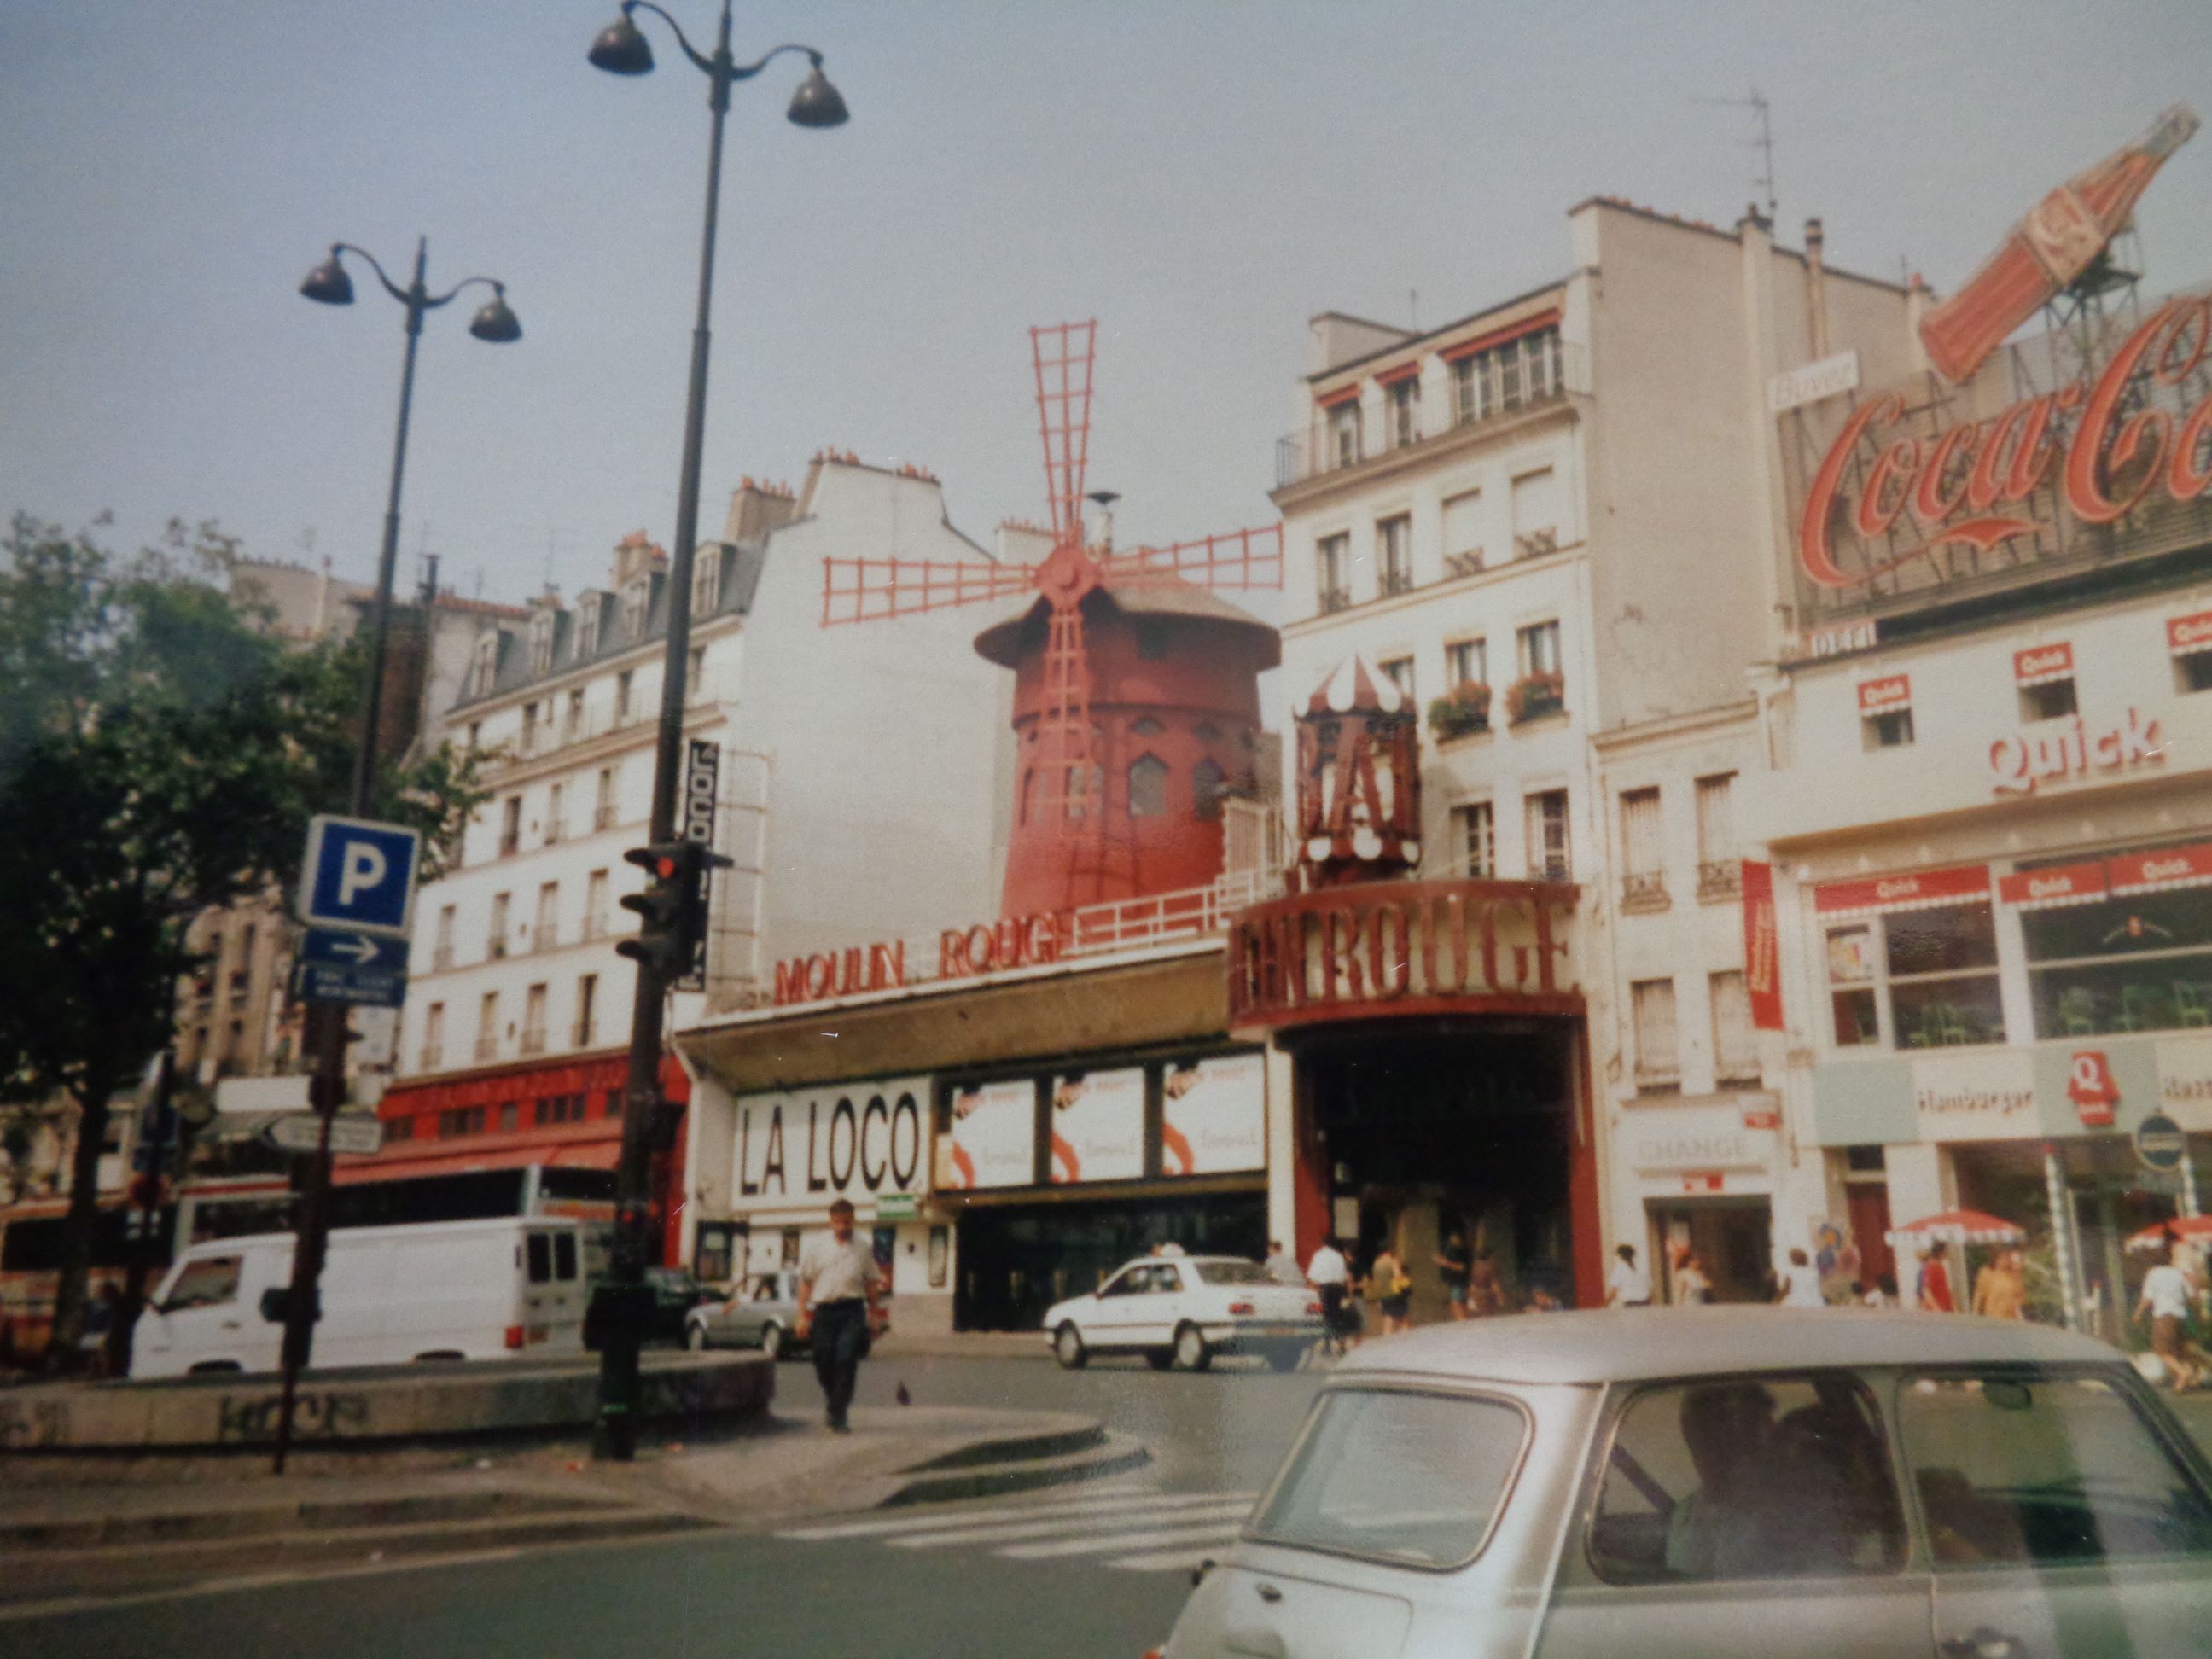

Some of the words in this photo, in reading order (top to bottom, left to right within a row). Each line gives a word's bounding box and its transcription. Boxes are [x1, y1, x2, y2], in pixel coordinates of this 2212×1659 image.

[1988, 707, 2168, 796] Quick
[339, 841, 386, 905] P
[773, 937, 905, 1006] MOULIN
[1321, 896, 1581, 1000] ROUGE
[741, 1104, 786, 1196] LA
[807, 1091, 920, 1192] LOCO
